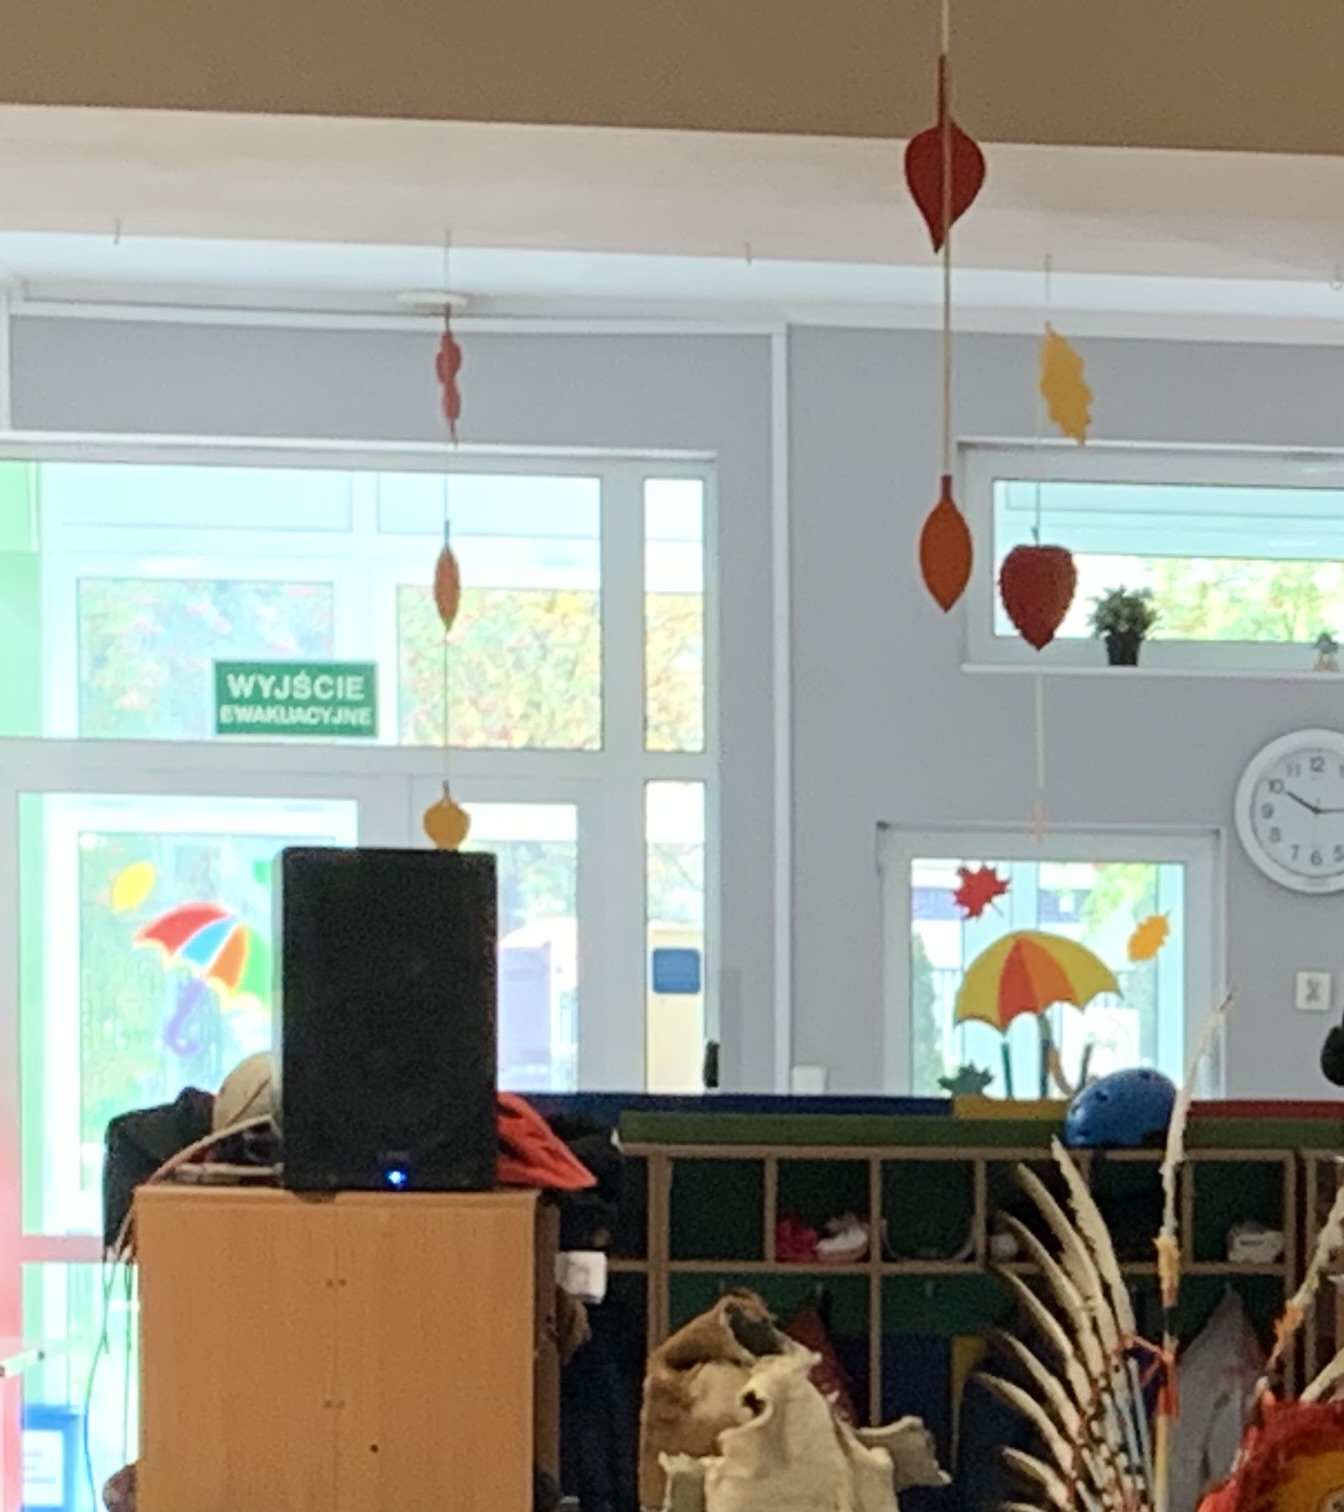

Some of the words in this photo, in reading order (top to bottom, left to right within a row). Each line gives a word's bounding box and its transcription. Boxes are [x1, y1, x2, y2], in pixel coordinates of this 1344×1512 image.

[226, 669, 365, 700] WYJŚCIE
[219, 703, 372, 726] EWAKUACYJNE
[1286, 763, 1301, 778] 11
[1309, 755, 1325, 773] 12
[1268, 778, 1285, 795] 10
[1261, 802, 1274, 820] 9
[1269, 826, 1281, 844] 8
[1291, 844, 1300, 861] 7
[1310, 850, 1323, 867] 6
